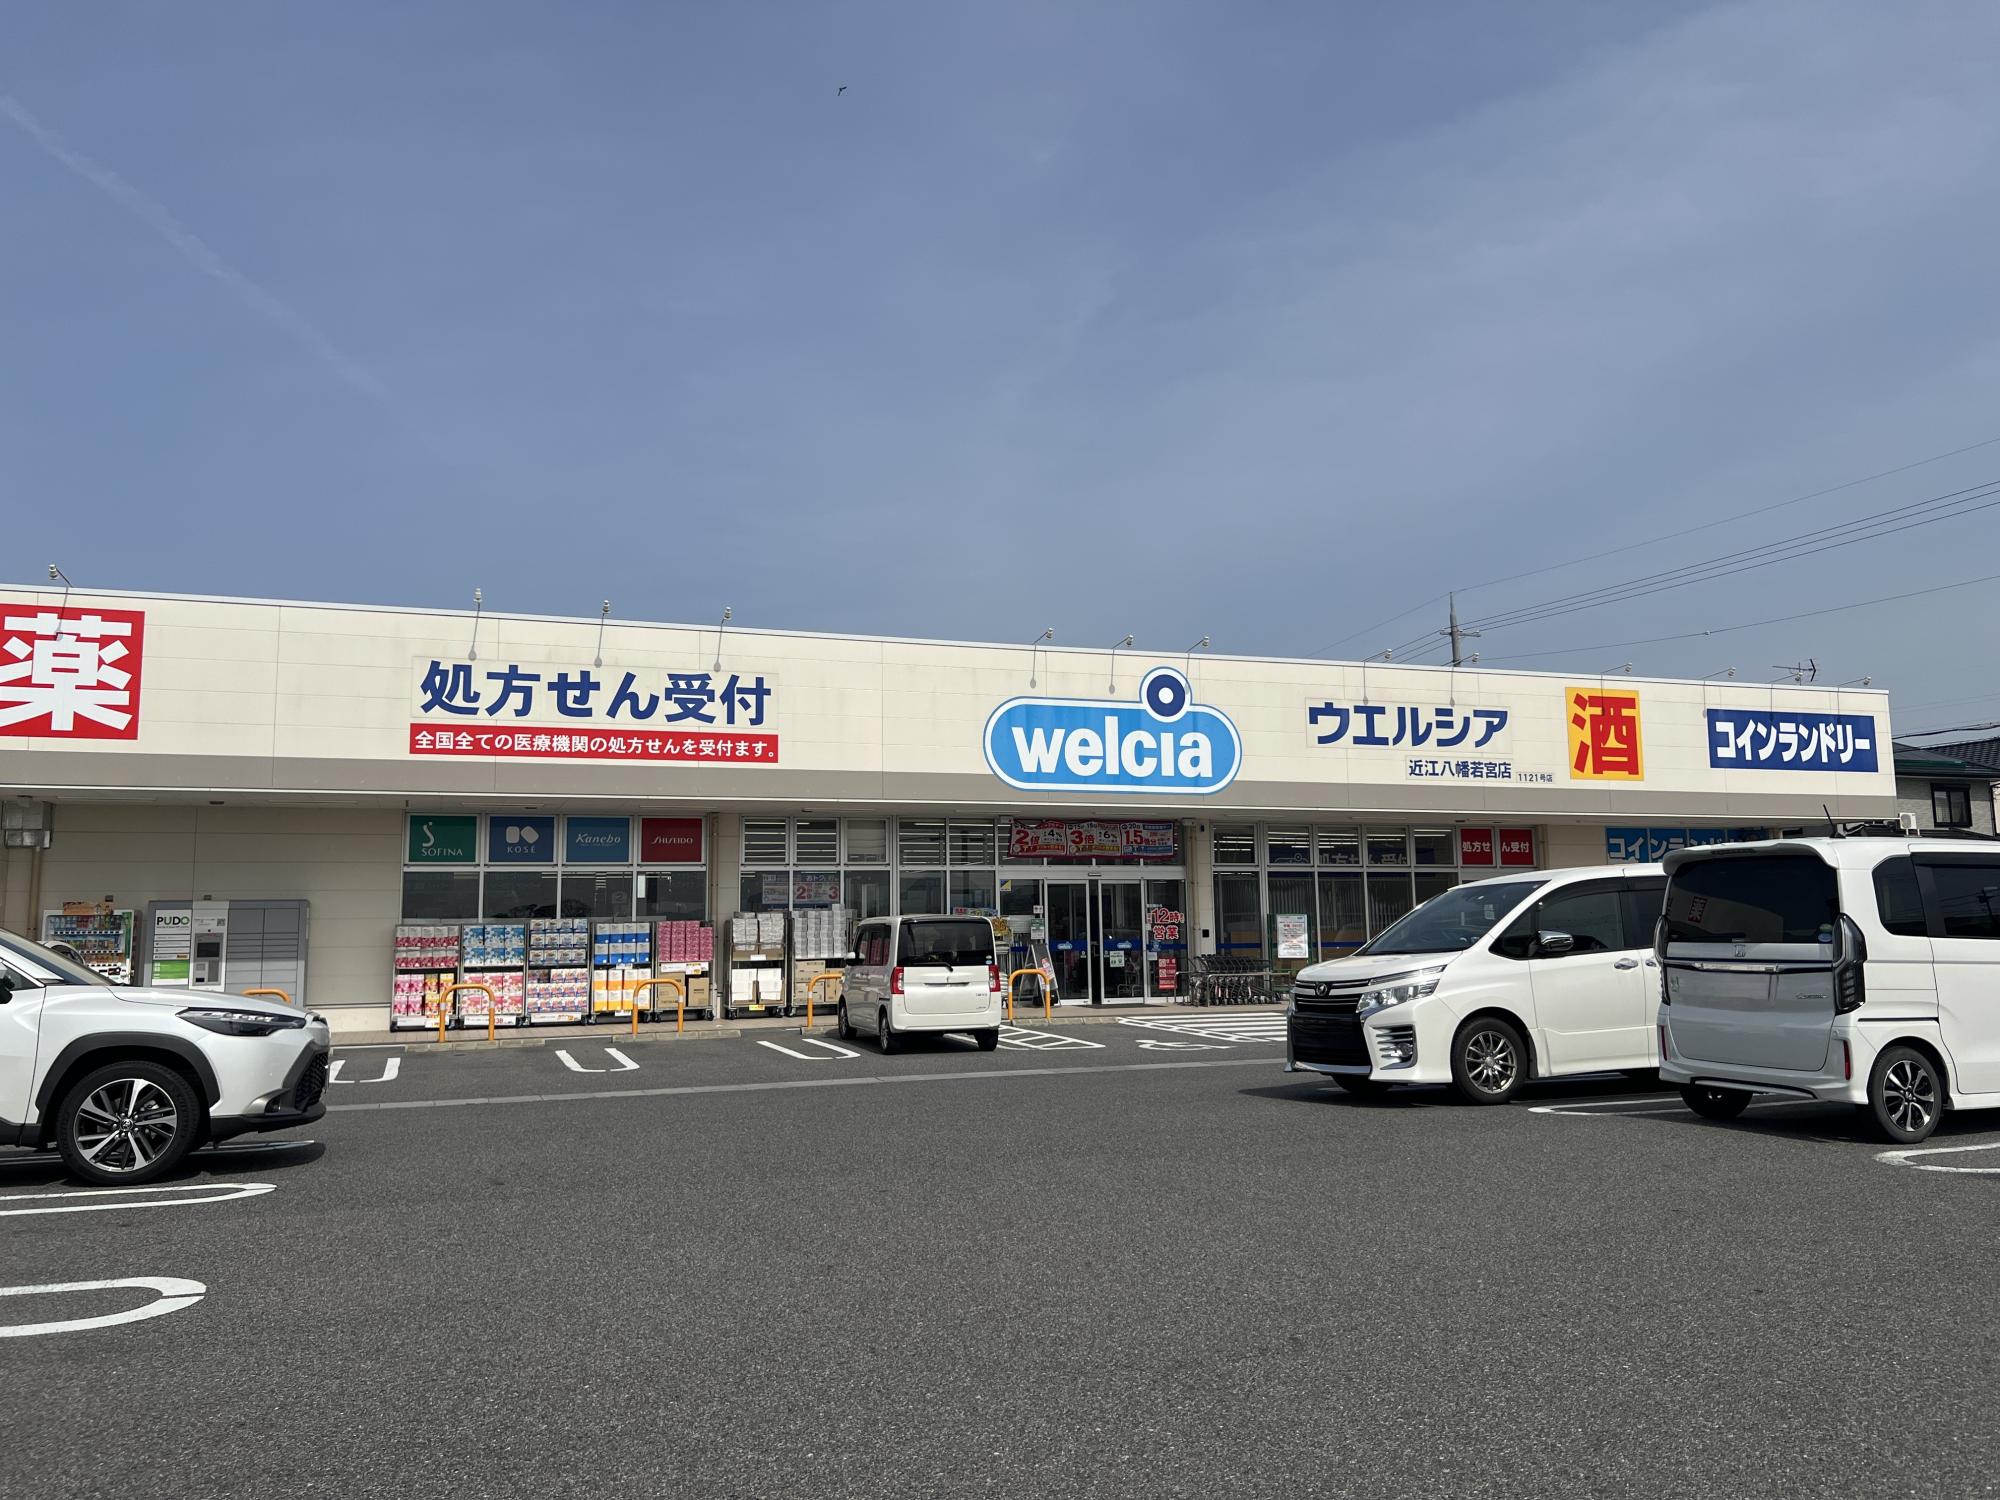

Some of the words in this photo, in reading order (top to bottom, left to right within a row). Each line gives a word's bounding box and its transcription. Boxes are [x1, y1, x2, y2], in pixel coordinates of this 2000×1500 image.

[0, 612, 132, 731] 薬
[420, 660, 771, 726] 処方せん受付
[1308, 701, 1508, 748] ウエルシア
[1572, 692, 1640, 776] 酒
[414, 730, 777, 759] 全国全ての医療機関の処方せんを受付ます。
[1011, 715, 1213, 778] welcia
[1715, 718, 1871, 764] コインランドリー
[1408, 759, 1512, 780] 近江八幡若宮店
[1518, 772, 1553, 783] 1121号店
[421, 848, 463, 857] SOFINA
[576, 833, 621, 844] Kanebo
[156, 916, 190, 926] PUDO
[1152, 925, 1179, 940] 営業
